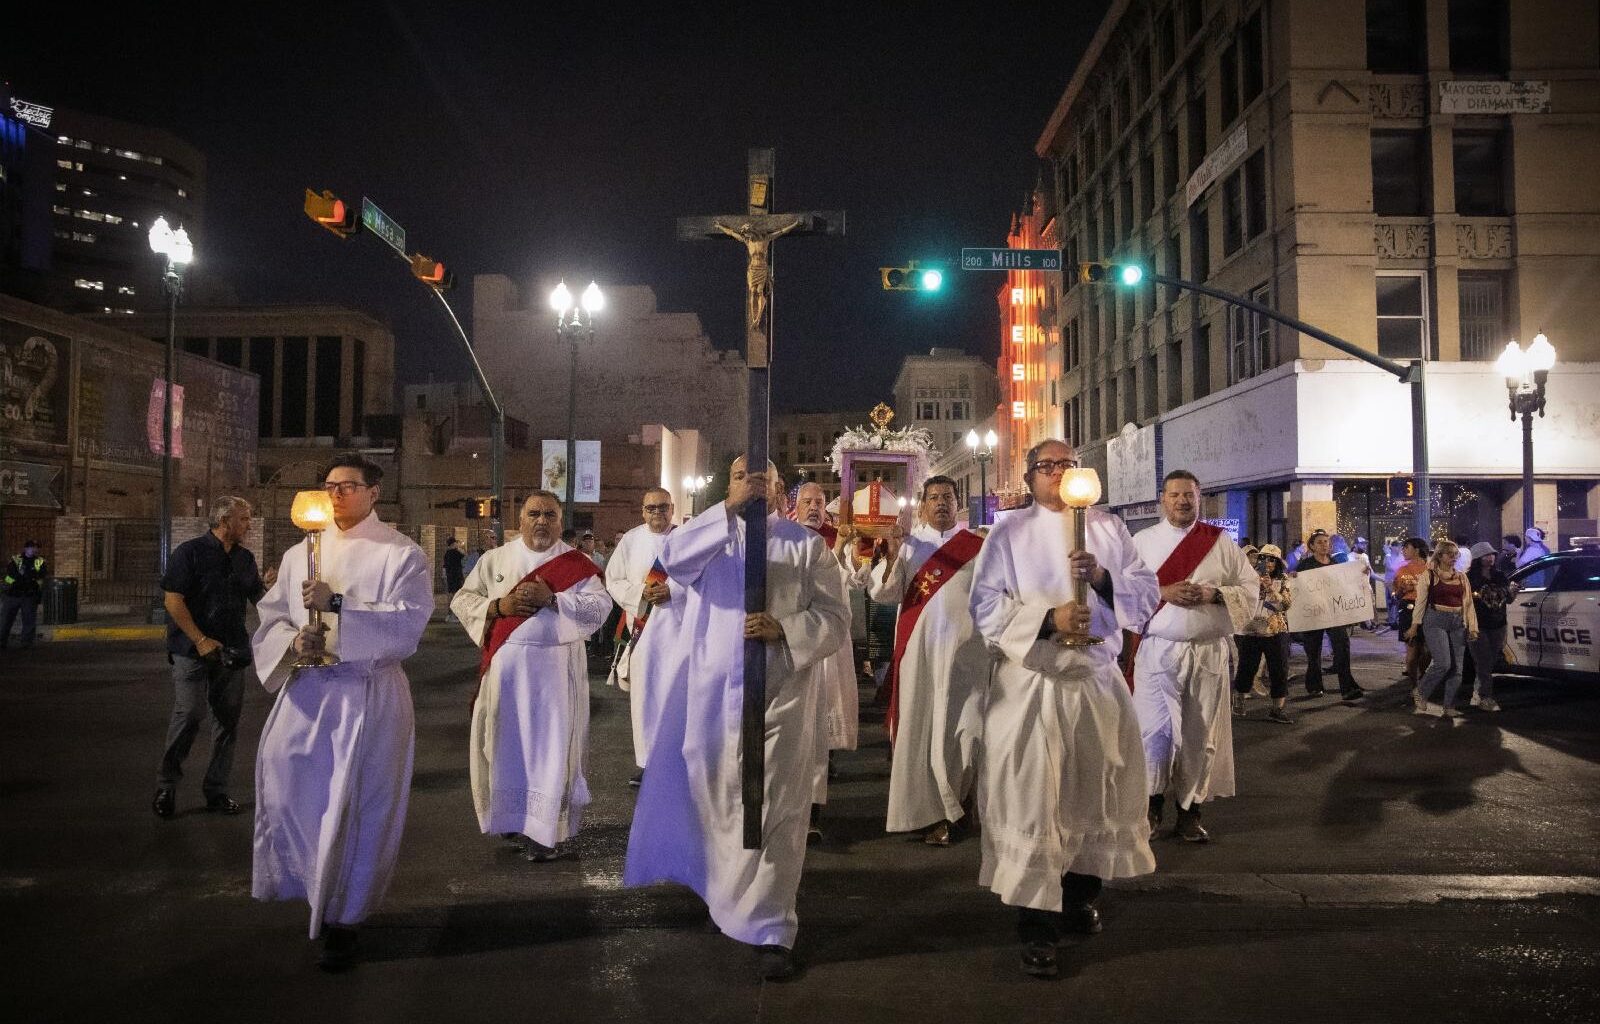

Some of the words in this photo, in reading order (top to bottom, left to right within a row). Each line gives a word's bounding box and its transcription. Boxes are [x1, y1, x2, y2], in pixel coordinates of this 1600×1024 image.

[1443, 84, 1501, 95] MAYOREO
[1505, 84, 1545, 95] JAS
[1450, 98, 1459, 109] Y
[1467, 97, 1540, 109] DIAMANTES
[965, 256, 982, 266] 200
[992, 251, 1031, 267] Mills
[1042, 258, 1057, 268] 100
[1011, 288, 1025, 418] RESS
[1406, 481, 1414, 497] 3
[1512, 625, 1592, 645] POLICE
